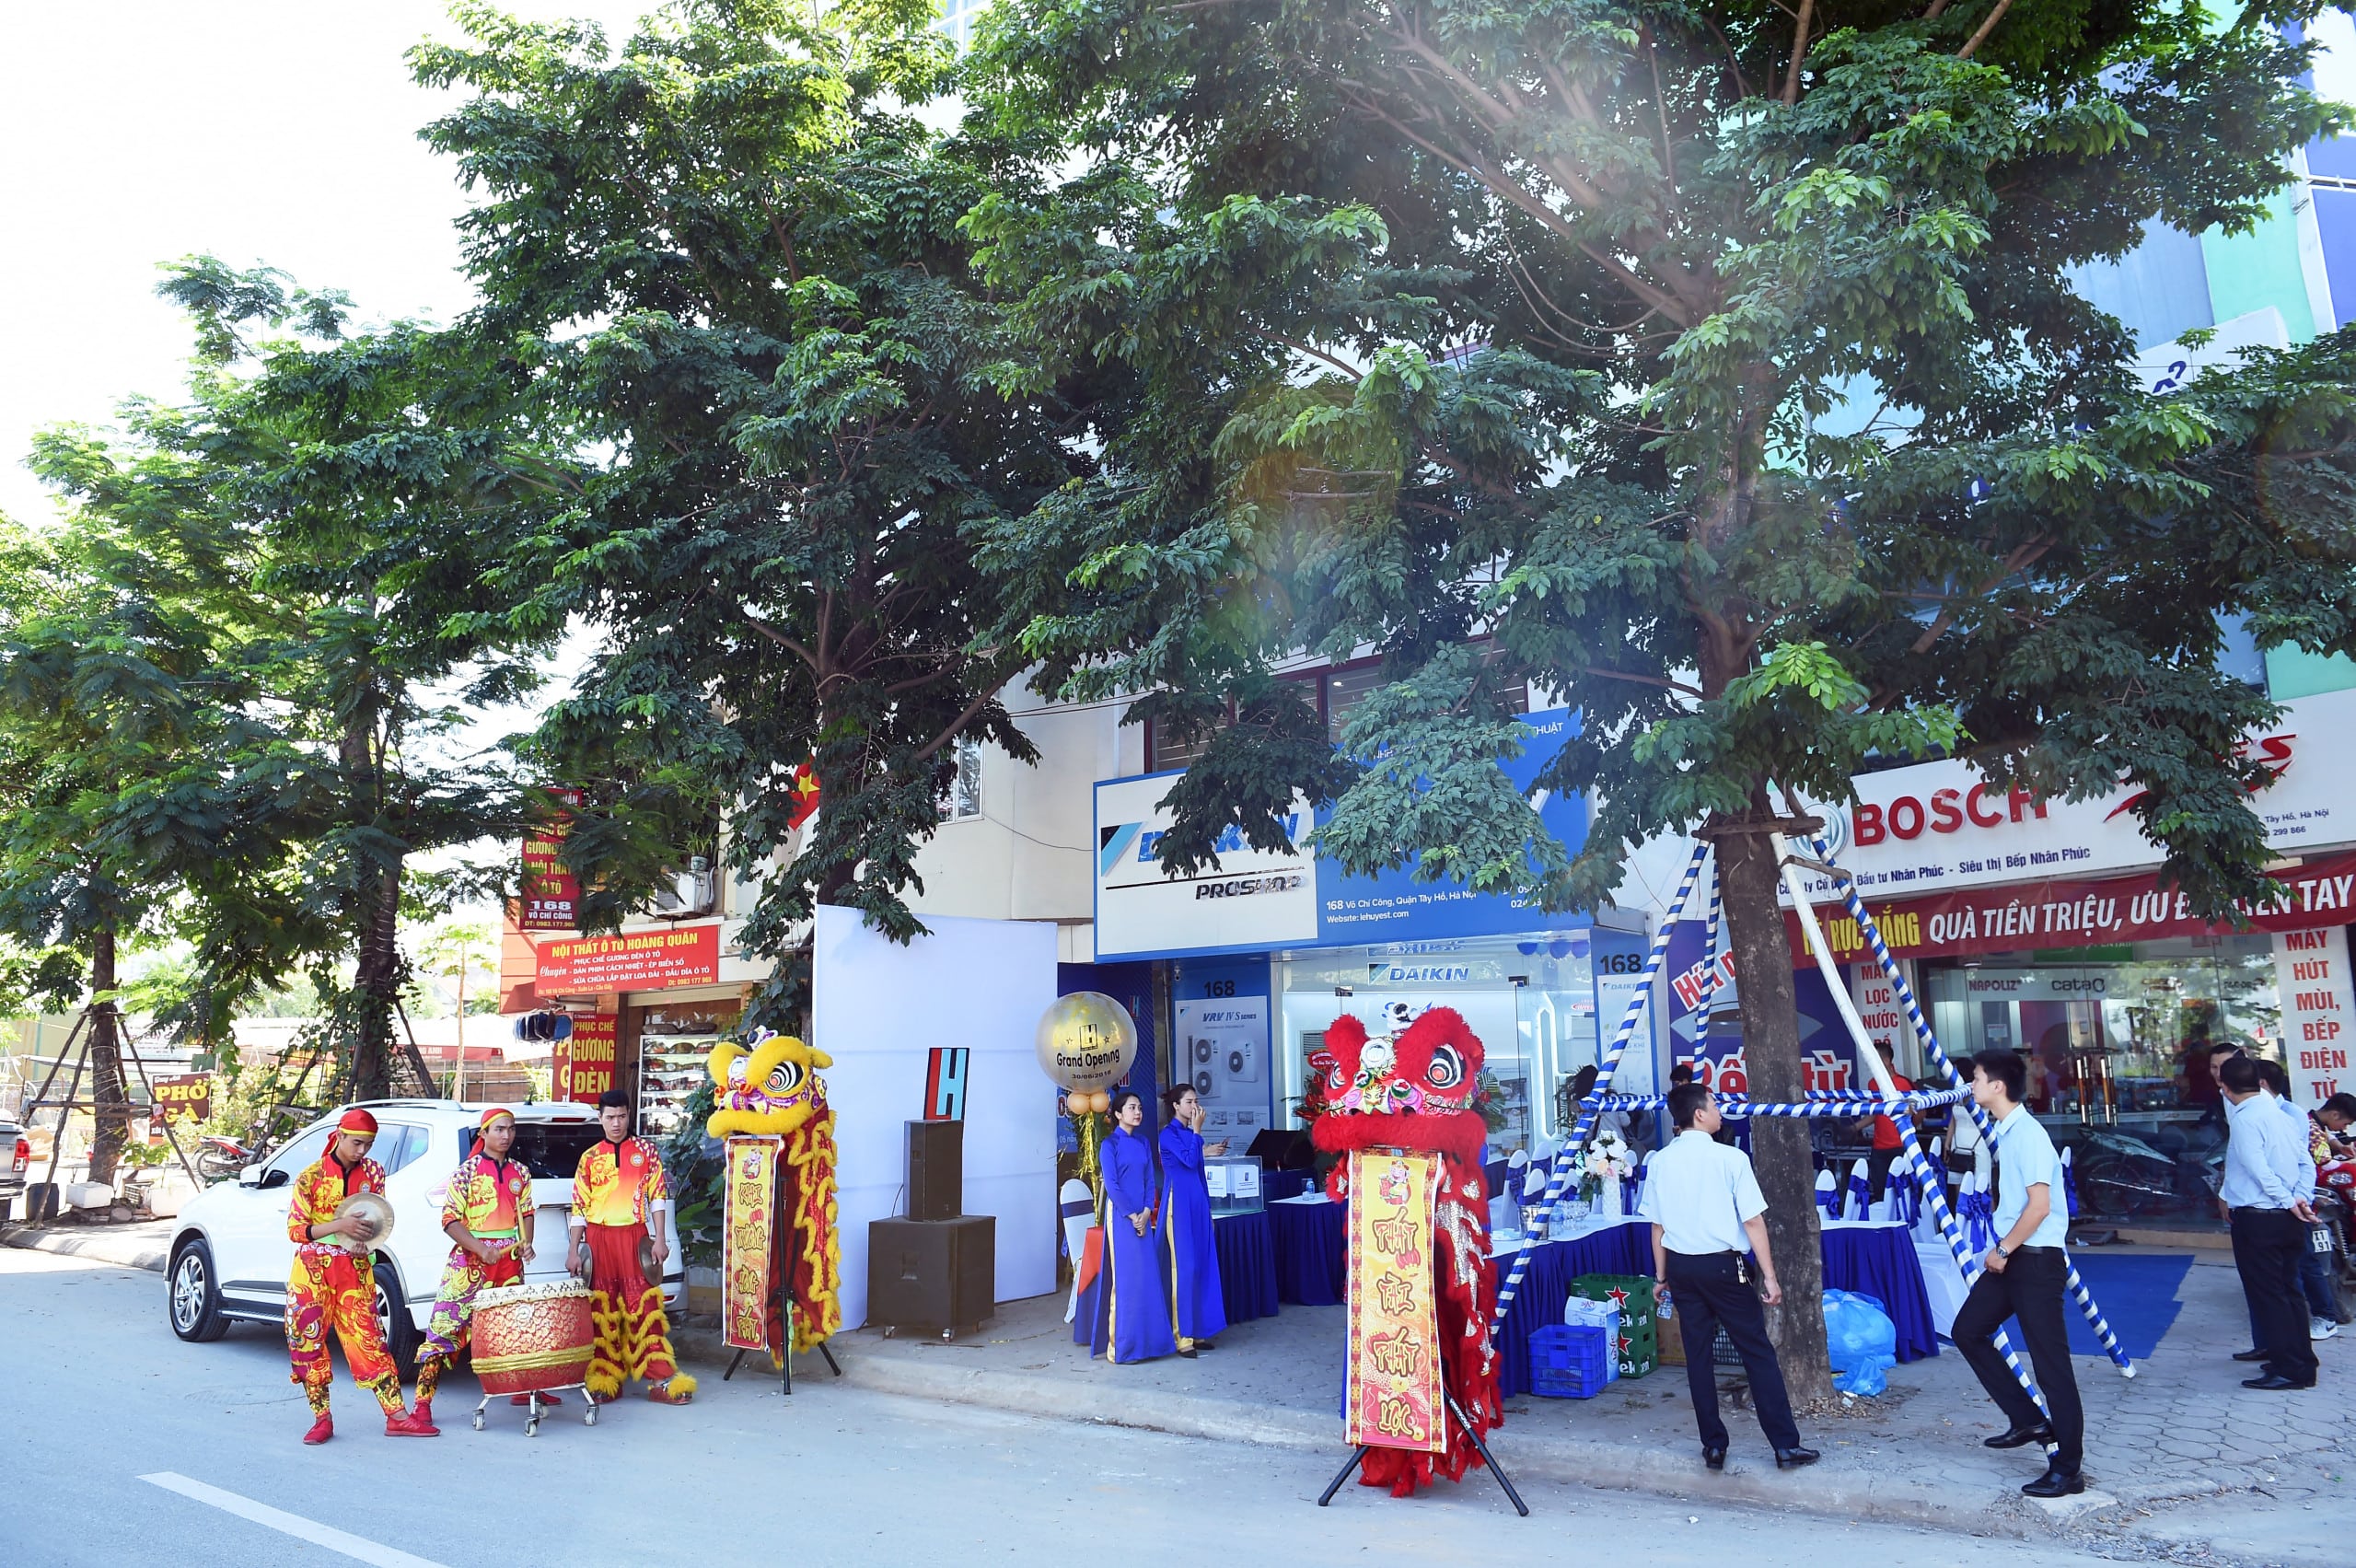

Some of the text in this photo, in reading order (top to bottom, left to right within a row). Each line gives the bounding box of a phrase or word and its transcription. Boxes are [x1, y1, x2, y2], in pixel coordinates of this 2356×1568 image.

[1852, 779, 2049, 847] BOSCH
[1891, 867, 1916, 882] Nhân
[1919, 864, 1944, 879] Phúc
[1959, 856, 1983, 874] Siêu
[1986, 854, 2002, 872] thị
[2005, 851, 2026, 868] Bếp
[2030, 848, 2059, 865] Nhân
[2061, 844, 2091, 864] Phúc
[530, 900, 572, 910] 168
[1327, 900, 1343, 911] 168
[1358, 899, 1370, 908] Chí
[1372, 898, 1395, 908] Công,
[1396, 896, 1417, 906] Quận
[1418, 893, 1432, 904] Tây
[1449, 890, 1460, 900] Hà
[540, 911, 551, 919] CHÍ
[553, 911, 573, 920] CÔNG
[1327, 913, 1359, 923] Website:
[1829, 917, 1864, 958] RỰC
[1930, 905, 1977, 945] QUÀ
[1982, 898, 2037, 937] TIỀN
[2043, 893, 2123, 937] TRIỆU,
[2130, 889, 2169, 924] ƯU
[2297, 874, 2356, 913] TAY
[552, 944, 570, 958] NỘI
[573, 940, 598, 957] THẤT
[601, 939, 609, 953] Ô
[627, 935, 664, 950] HOÀNG
[667, 931, 698, 947] QUÂN
[2285, 929, 2327, 951] MÁY
[1388, 968, 1469, 981] DAIKIN
[1600, 953, 1642, 973] 168
[2293, 958, 2329, 981] HÚT
[1204, 980, 1235, 997] 168
[1865, 988, 1890, 1007] LỌC
[2295, 988, 2340, 1011] MÙI,
[574, 1018, 616, 1034] PHỤC CHẾ
[1202, 1012, 1224, 1022] VRV
[1863, 1008, 1898, 1029] NƯỚC
[2303, 1016, 2340, 1041] BẾP
[572, 1037, 615, 1062] GƯƠNG
[1056, 1048, 1120, 1069] Grand Opening
[2300, 1046, 2348, 1074] ĐIỆN
[154, 1078, 208, 1102] PHỞ
[574, 1066, 610, 1094] ĐÈN
[2311, 1076, 2338, 1100] TỪ
[165, 1102, 201, 1123] GÀ
[1373, 1207, 1418, 1255] PHÁT
[1376, 1272, 1415, 1317] TÀI
[1373, 1327, 1419, 1377] PHÁT
